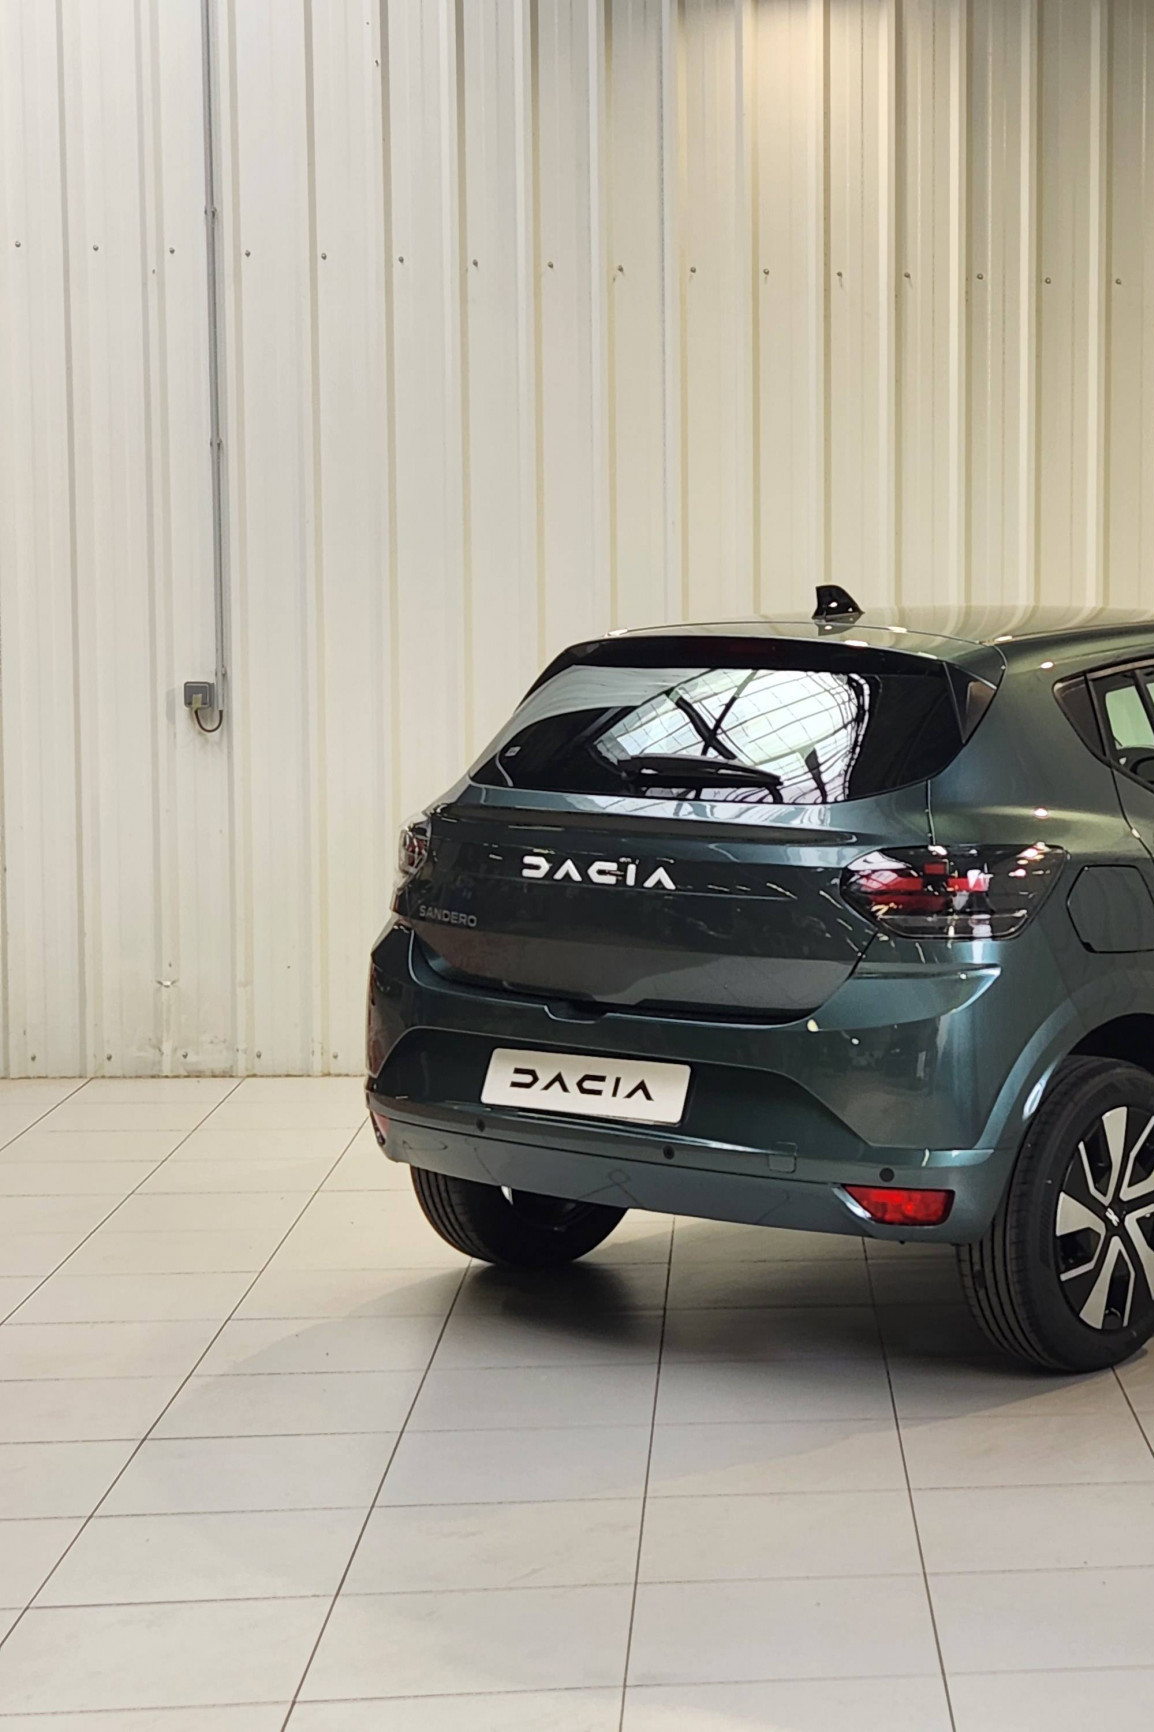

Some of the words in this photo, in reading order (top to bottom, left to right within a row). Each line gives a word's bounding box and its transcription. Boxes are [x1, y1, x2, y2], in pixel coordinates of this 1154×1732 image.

[521, 855, 677, 890] DACIA
[419, 904, 478, 928] SANDERO
[509, 1066, 655, 1101] DACIA
